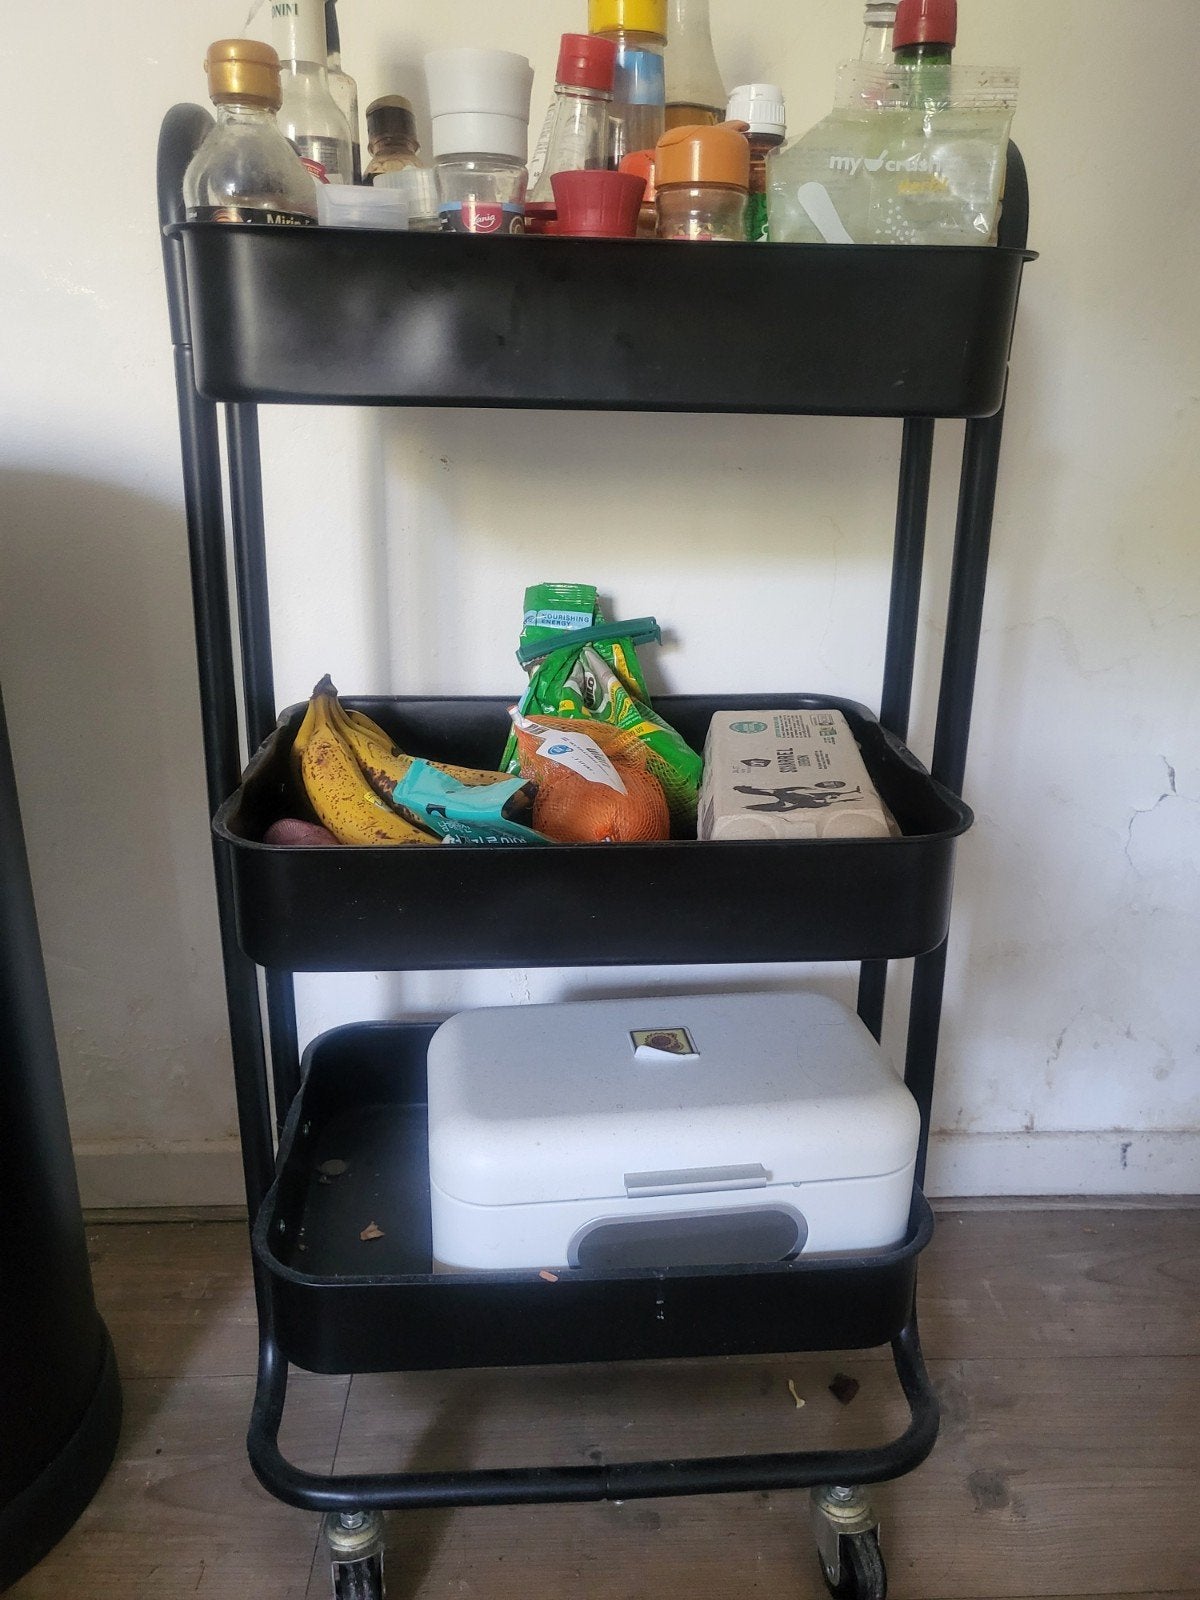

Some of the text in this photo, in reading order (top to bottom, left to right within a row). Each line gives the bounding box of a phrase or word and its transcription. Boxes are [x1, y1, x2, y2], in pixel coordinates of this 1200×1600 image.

[829, 156, 863, 176] my
[541, 613, 590, 624] NOURISHING
[541, 619, 571, 627] ENERGY
